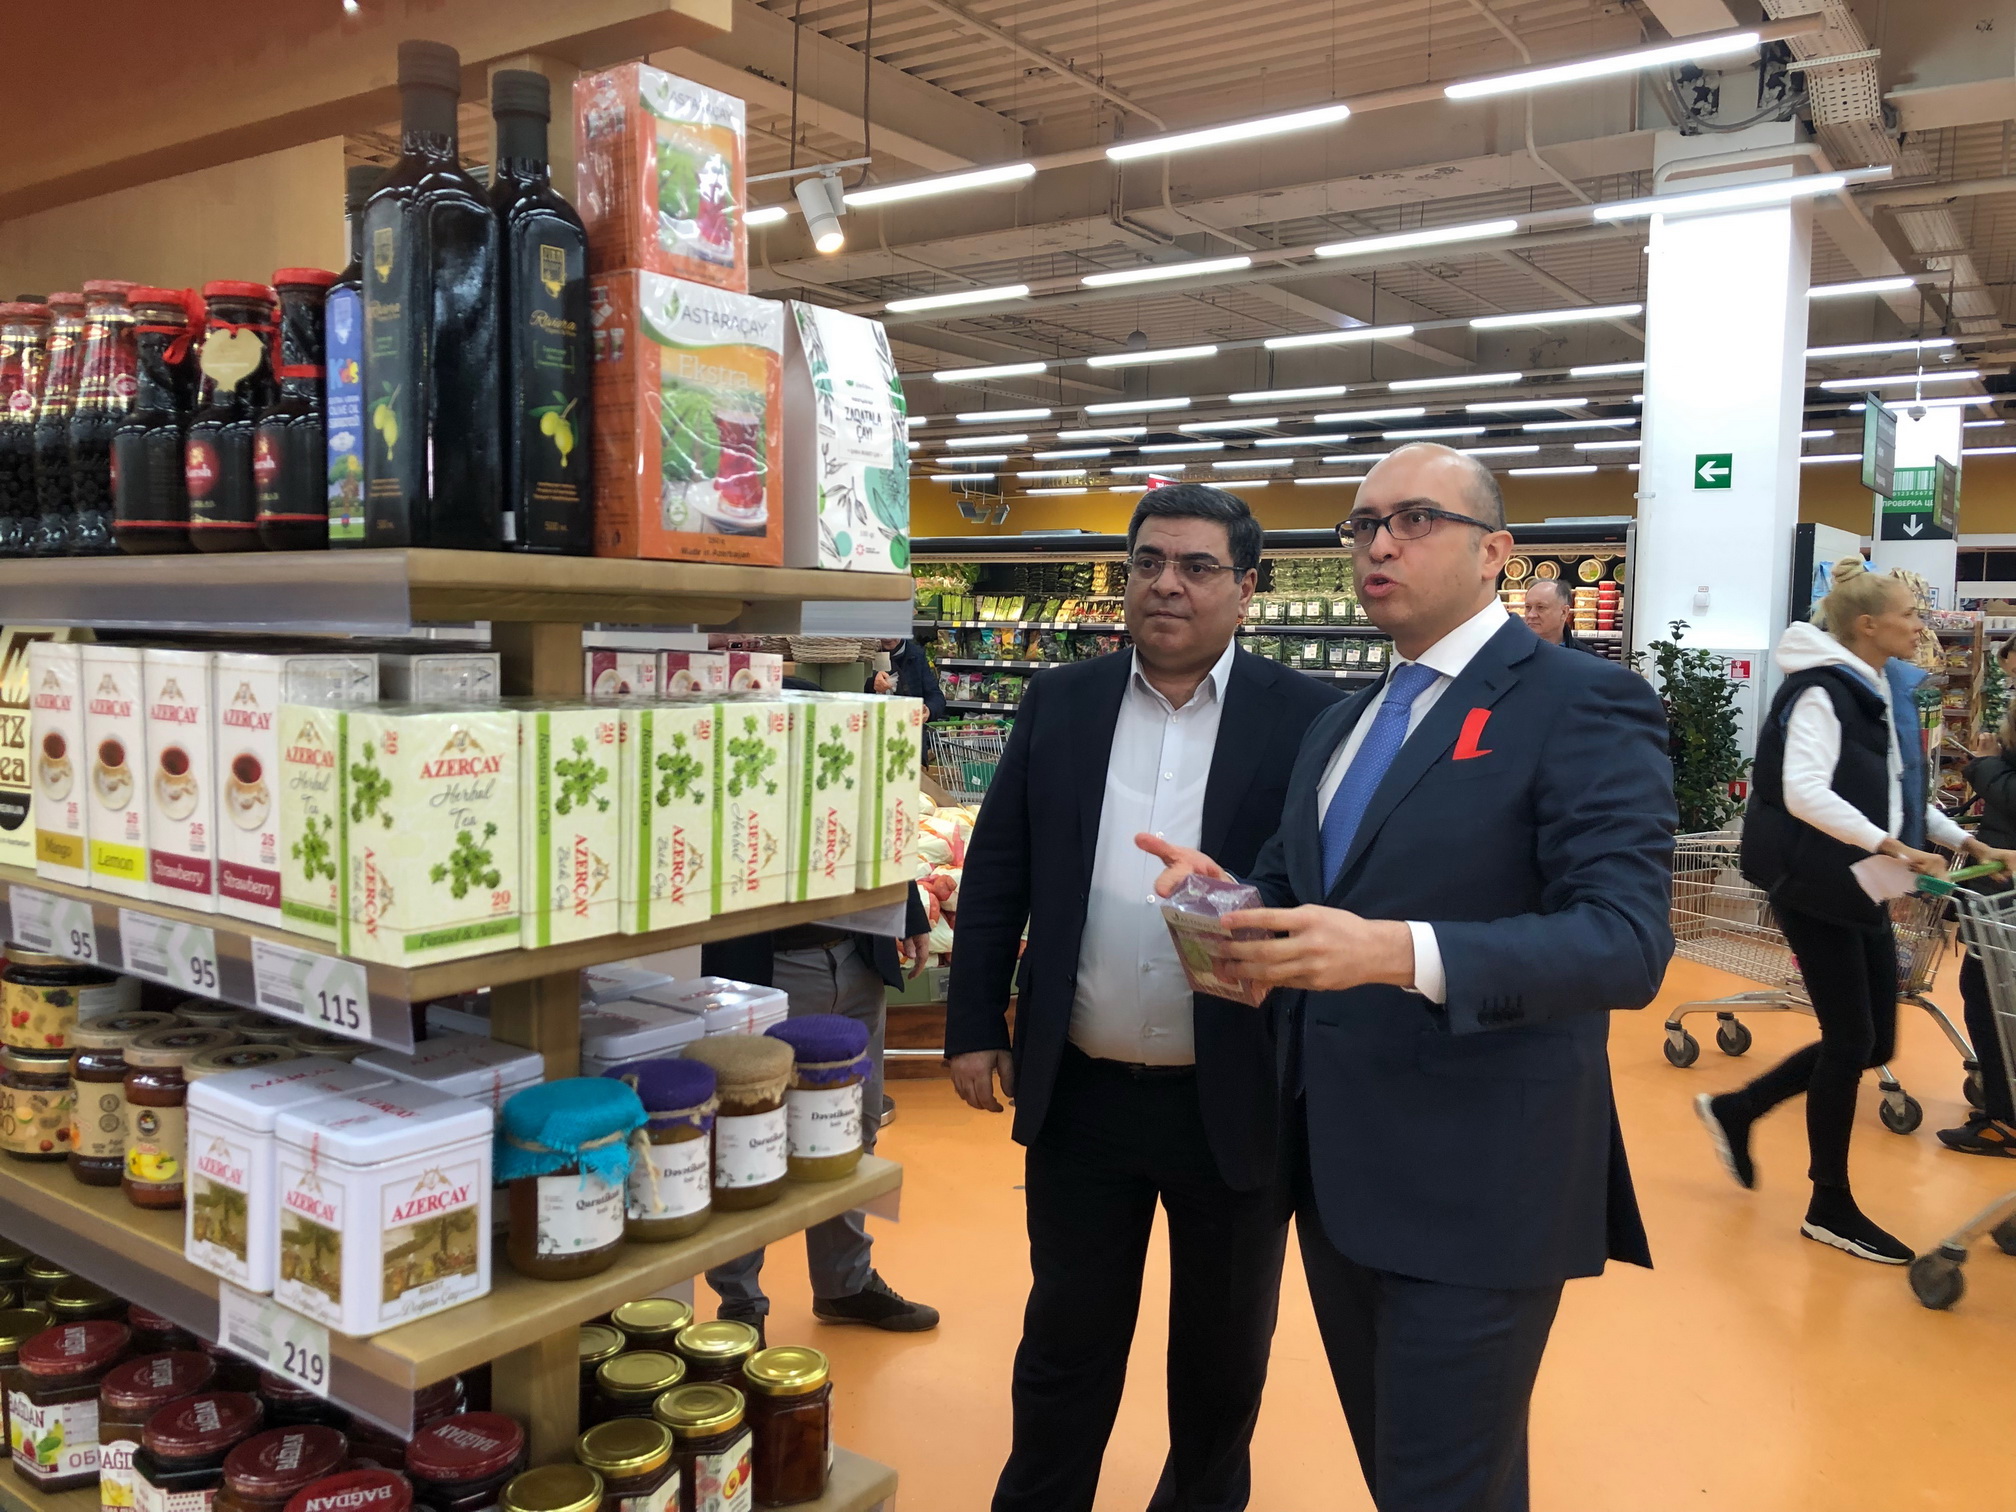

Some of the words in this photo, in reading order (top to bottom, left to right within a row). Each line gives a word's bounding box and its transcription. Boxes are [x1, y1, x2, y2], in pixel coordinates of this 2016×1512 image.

[669, 91, 733, 123] ASTAÇAY
[682, 305, 767, 338] ASTARAÇAY
[1883, 500, 1923, 508] ПРОВЕРКА
[222, 708, 272, 732] AZERÇAY
[285, 746, 335, 769] AZERÇAY
[419, 754, 504, 779] AZERÇAY
[430, 778, 496, 807] Herbal
[449, 807, 477, 829] Tea
[894, 797, 904, 865] AZERÇAY
[747, 809, 760, 892] АЗЕРЧАЙ
[825, 806, 838, 880] AZERÇAY
[153, 859, 206, 887] Strawberry
[573, 834, 589, 919] AZERÇAY
[671, 825, 685, 905] AZERÇAY
[222, 869, 275, 899] Strawberry
[329, 884, 337, 899] 2
[364, 847, 378, 936] AZERÇAY
[492, 889, 511, 907] 20
[71, 929, 92, 958] 95
[190, 956, 216, 989] 95
[317, 989, 360, 1030] 115
[198, 1156, 243, 1184] AZERÇAY
[286, 1190, 336, 1222] AZERÇAY
[391, 1182, 471, 1222] AZERÇAY
[283, 1341, 324, 1385] 219
[69, 1449, 100, 1468] ОБ
[305, 1484, 393, 1512] BAĞDAN
